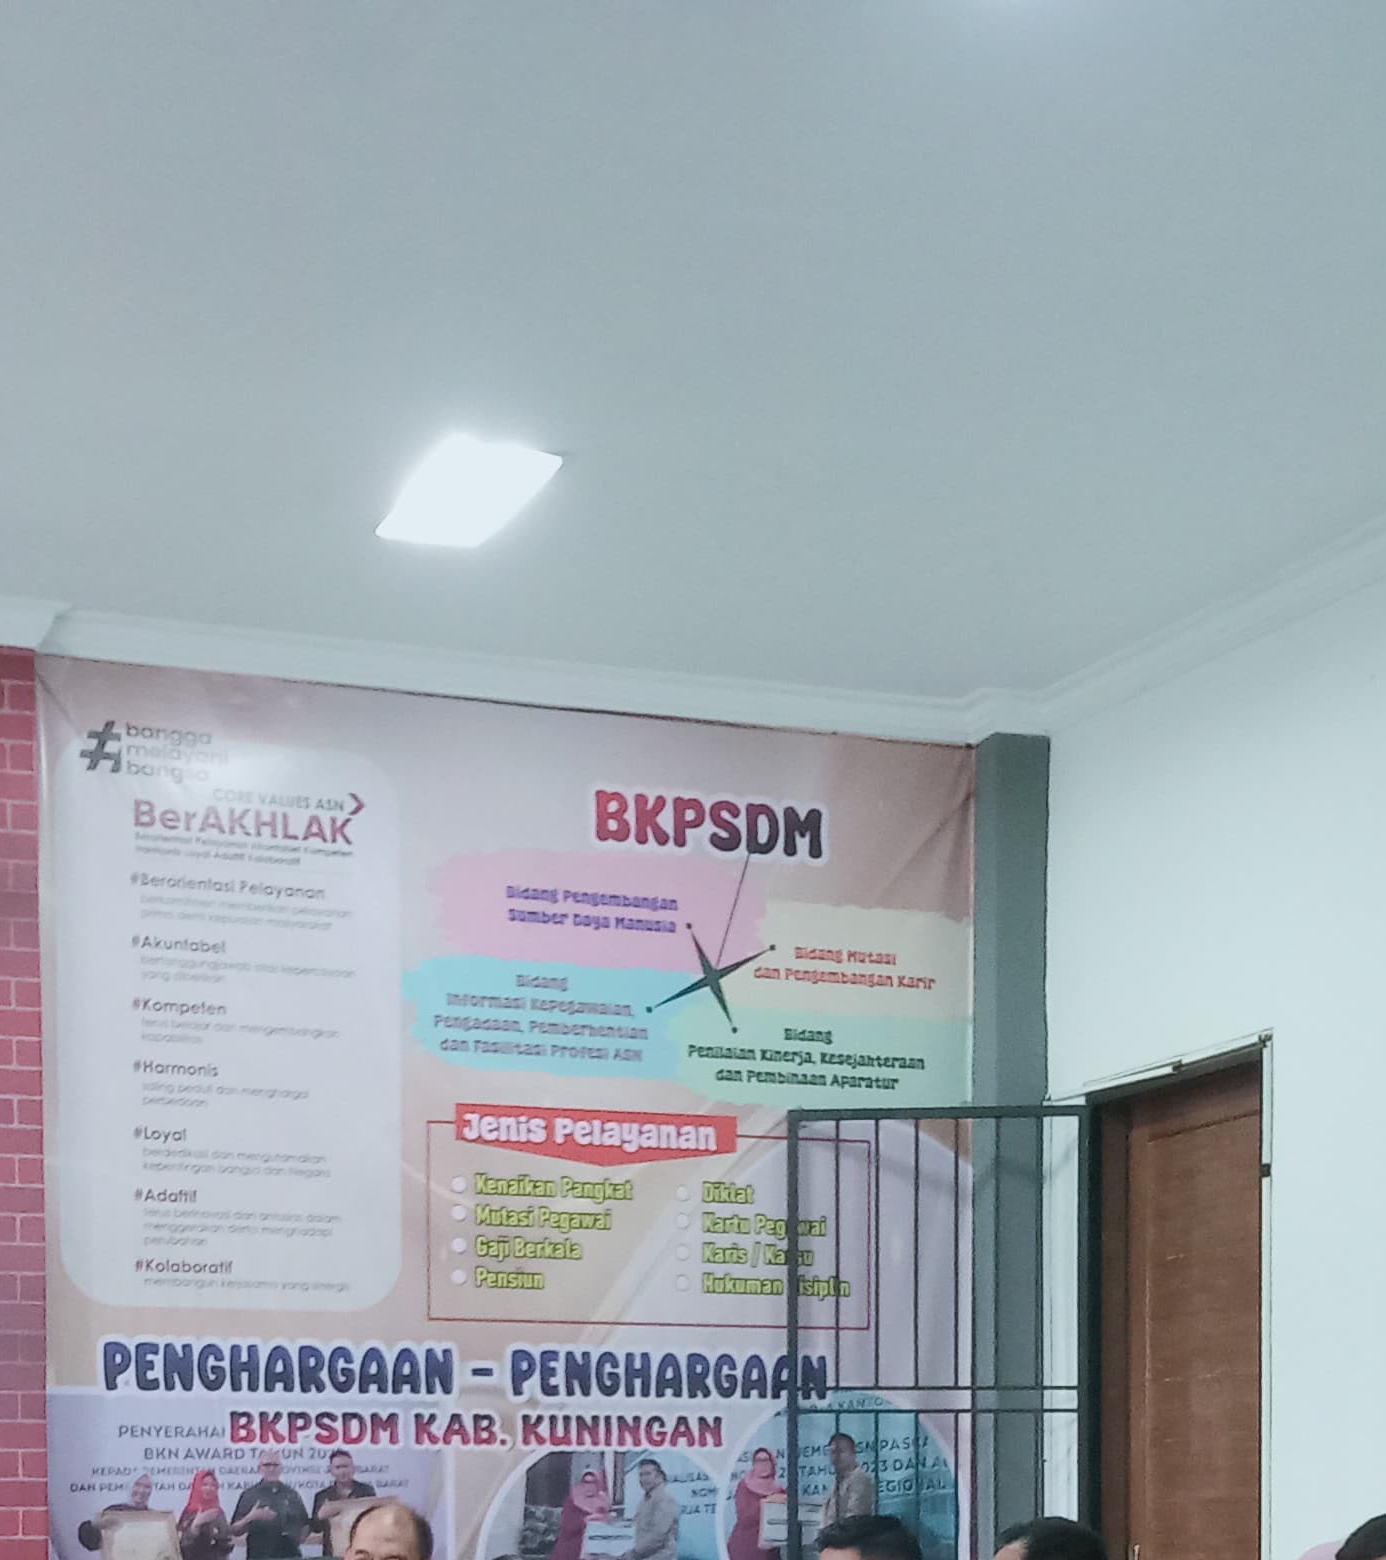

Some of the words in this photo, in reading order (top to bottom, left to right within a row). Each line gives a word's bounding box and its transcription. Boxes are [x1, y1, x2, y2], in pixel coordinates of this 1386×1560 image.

[126, 721, 212, 746] bangga
[315, 795, 345, 812] ASN
[134, 798, 354, 845] BerAKHLAK
[594, 789, 823, 859] BKPSDM
[239, 880, 326, 900] Pelayanan
[506, 885, 558, 904] Bidang
[562, 889, 678, 912] Pengembangan
[508, 908, 568, 926] Sumber
[573, 913, 610, 931] Daya
[615, 916, 676, 933] Manusia
[794, 946, 843, 964] Bidang
[847, 949, 897, 966] Mutasi
[516, 974, 568, 992] Bidang
[754, 966, 781, 980] dan
[784, 968, 894, 988] Pengembangan
[897, 974, 936, 990] Karir
[440, 1038, 469, 1052] dan
[784, 1028, 833, 1045] Bidang
[133, 1060, 220, 1078] #Harmonis
[687, 1044, 756, 1060] Penilaian
[819, 1051, 925, 1070] Kesejahteraan
[715, 1069, 743, 1083] dan
[746, 1070, 826, 1086] Pembinaan
[830, 1074, 899, 1090] Aparatur
[134, 1127, 187, 1144] #Loyal
[463, 1113, 548, 1144] Jenis
[554, 1117, 717, 1152] Pelayanan
[475, 1172, 557, 1198] Kenaikan
[560, 1175, 633, 1204] Pangkat
[702, 1180, 755, 1205] Diklat
[475, 1204, 534, 1228] Mutasi
[538, 1206, 612, 1233] Pegawai
[702, 1211, 750, 1235] Kartu
[475, 1235, 510, 1262] Gaji
[513, 1236, 582, 1261] Berkala
[702, 1241, 748, 1265] Karis
[750, 1241, 762, 1268] /
[135, 1257, 234, 1275] #Kolaboratif
[475, 1266, 545, 1290] Pensiun
[702, 1272, 785, 1297] Hukuman
[103, 1342, 455, 1396] PENGHARGAAN
[510, 1348, 828, 1400] PENGHARGAAN
[229, 1410, 400, 1446] BKPSDM
[414, 1412, 508, 1447] KAB.
[521, 1413, 723, 1447] KUNINGAN
[144, 1447, 179, 1461] BKN
[183, 1447, 245, 1461] AWARD
[70, 1482, 95, 1493] DAN
